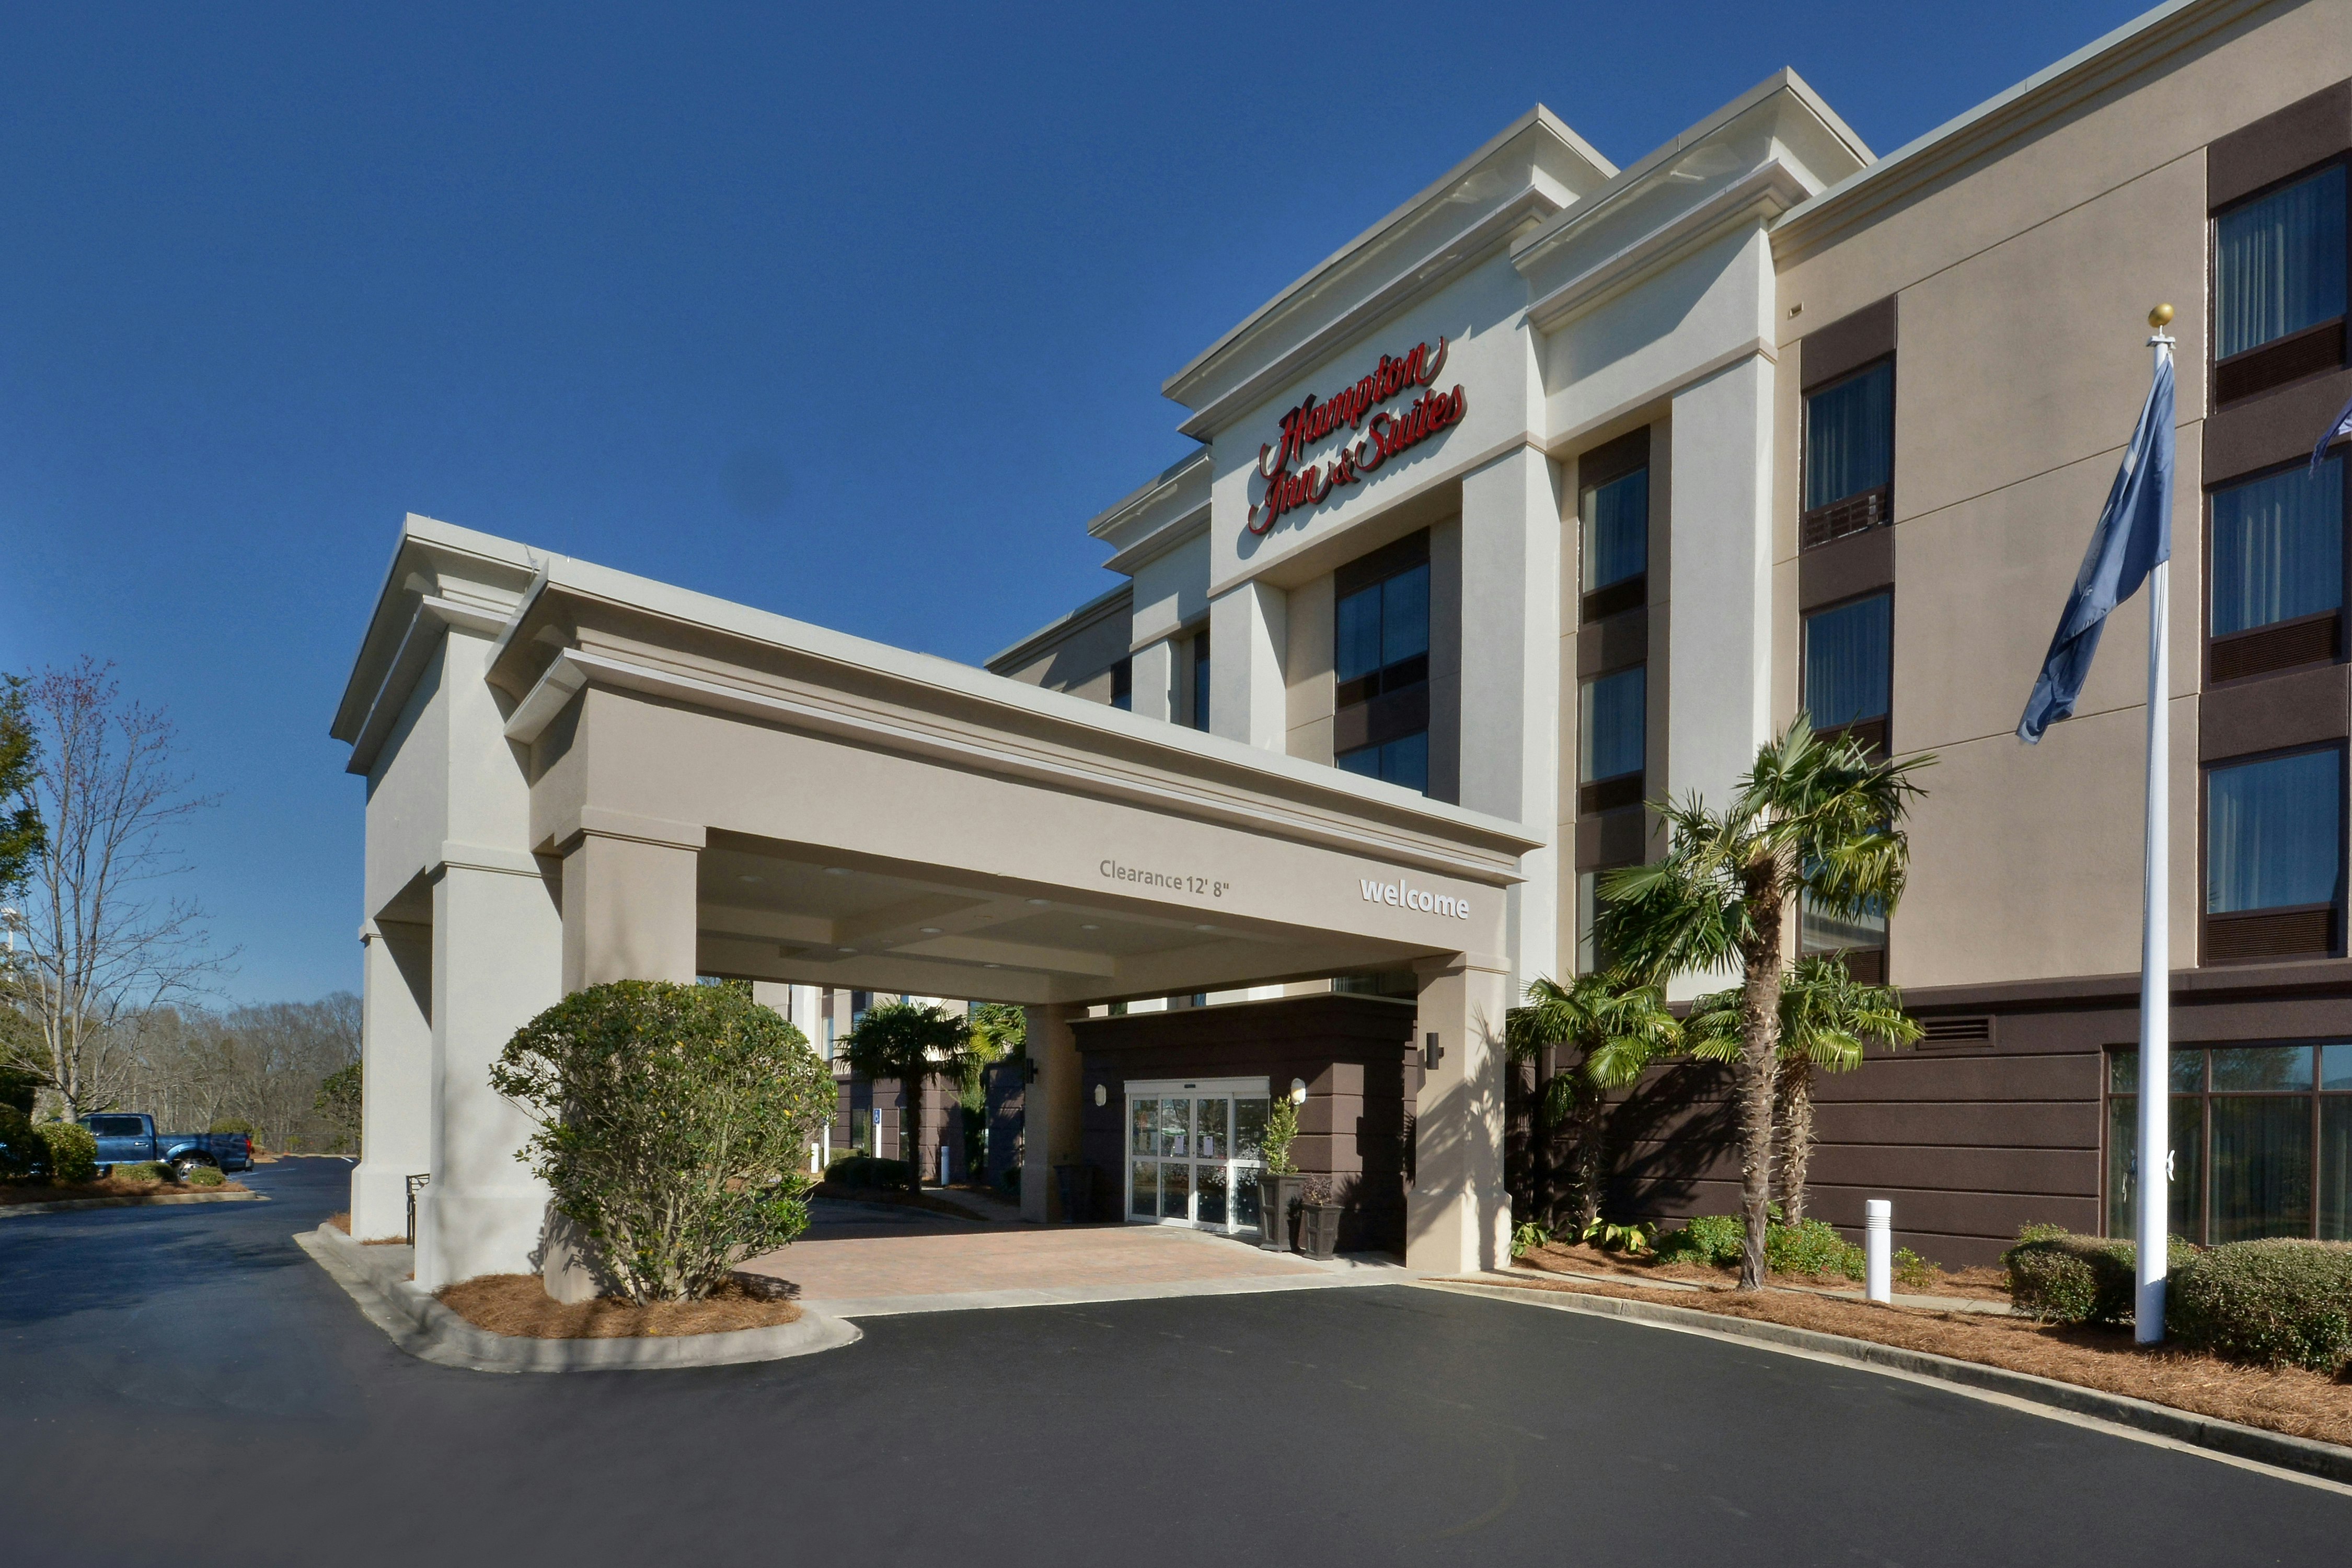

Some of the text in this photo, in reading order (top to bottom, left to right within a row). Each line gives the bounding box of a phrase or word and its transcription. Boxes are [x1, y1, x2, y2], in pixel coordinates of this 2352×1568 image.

[1259, 336, 1450, 479] Hampton
[1248, 383, 1468, 534] Inn & Suites
[1100, 860, 1230, 898] Clearance 12' 8"
[1359, 879, 1469, 919] welcome
